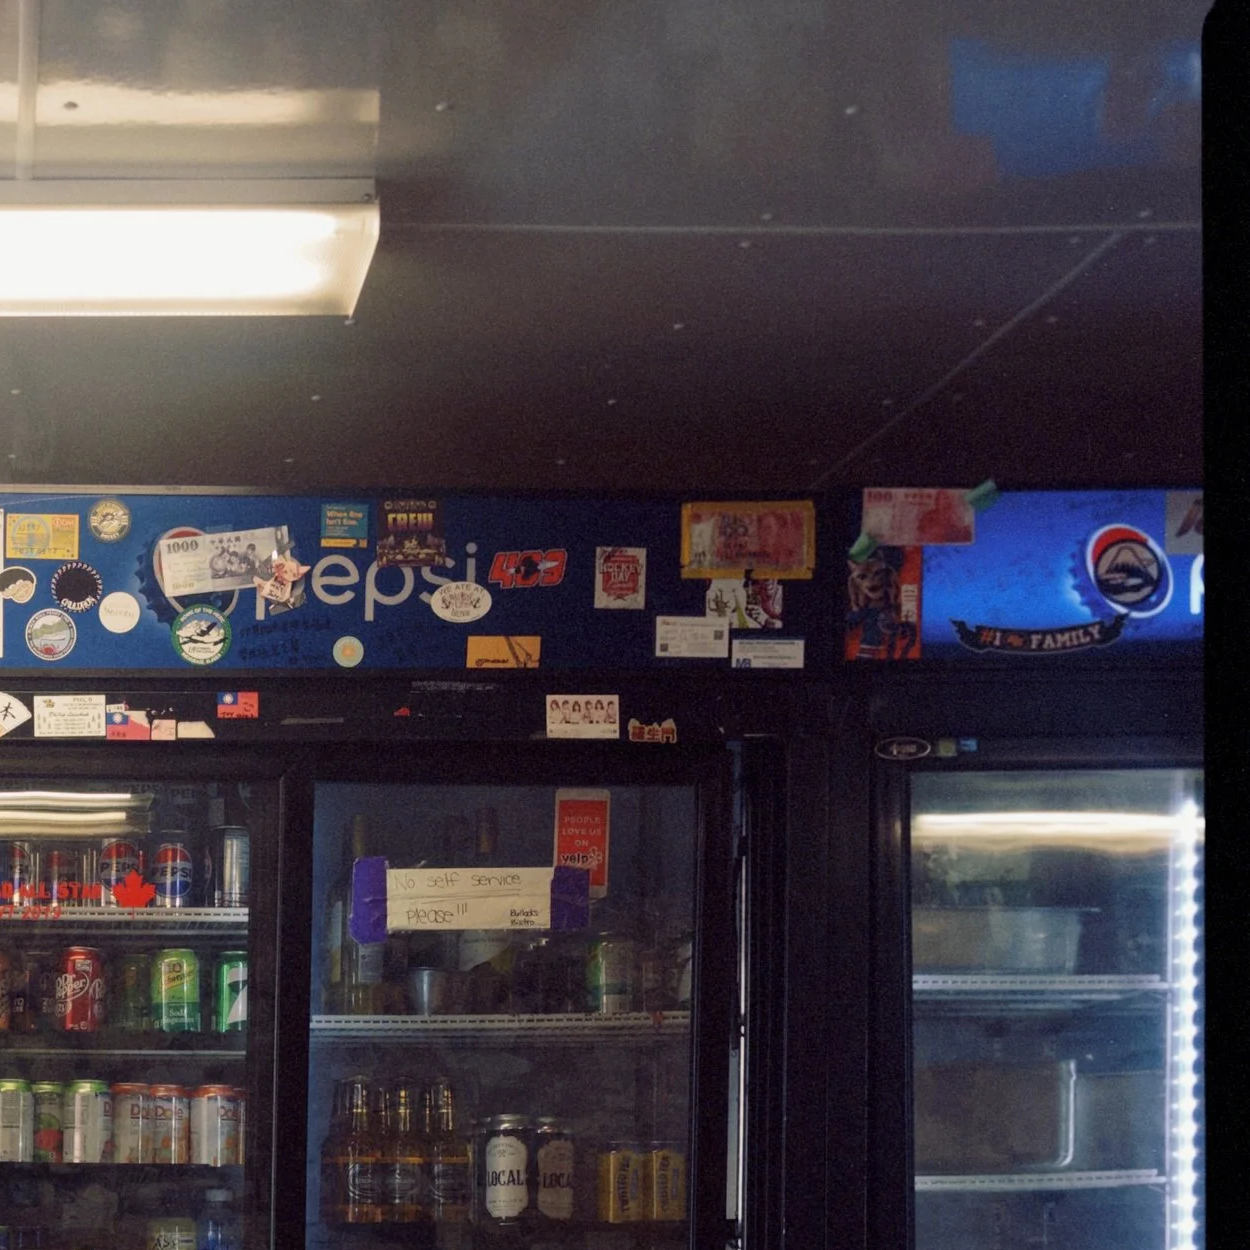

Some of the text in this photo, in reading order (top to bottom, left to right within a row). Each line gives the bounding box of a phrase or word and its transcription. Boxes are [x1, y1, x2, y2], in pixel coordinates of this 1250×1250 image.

[165, 540, 199, 554] 1000
[1030, 624, 1101, 649] FAMILY
[564, 816, 601, 825] PEOPLE
[562, 828, 602, 836] LOVE US
[574, 839, 589, 848] ON
[561, 852, 589, 865] yelp
[394, 869, 522, 890] No self service
[154, 1106, 183, 1118] Dole
[486, 1168, 524, 1187] LOCAL
[542, 1172, 573, 1189] LOCA
